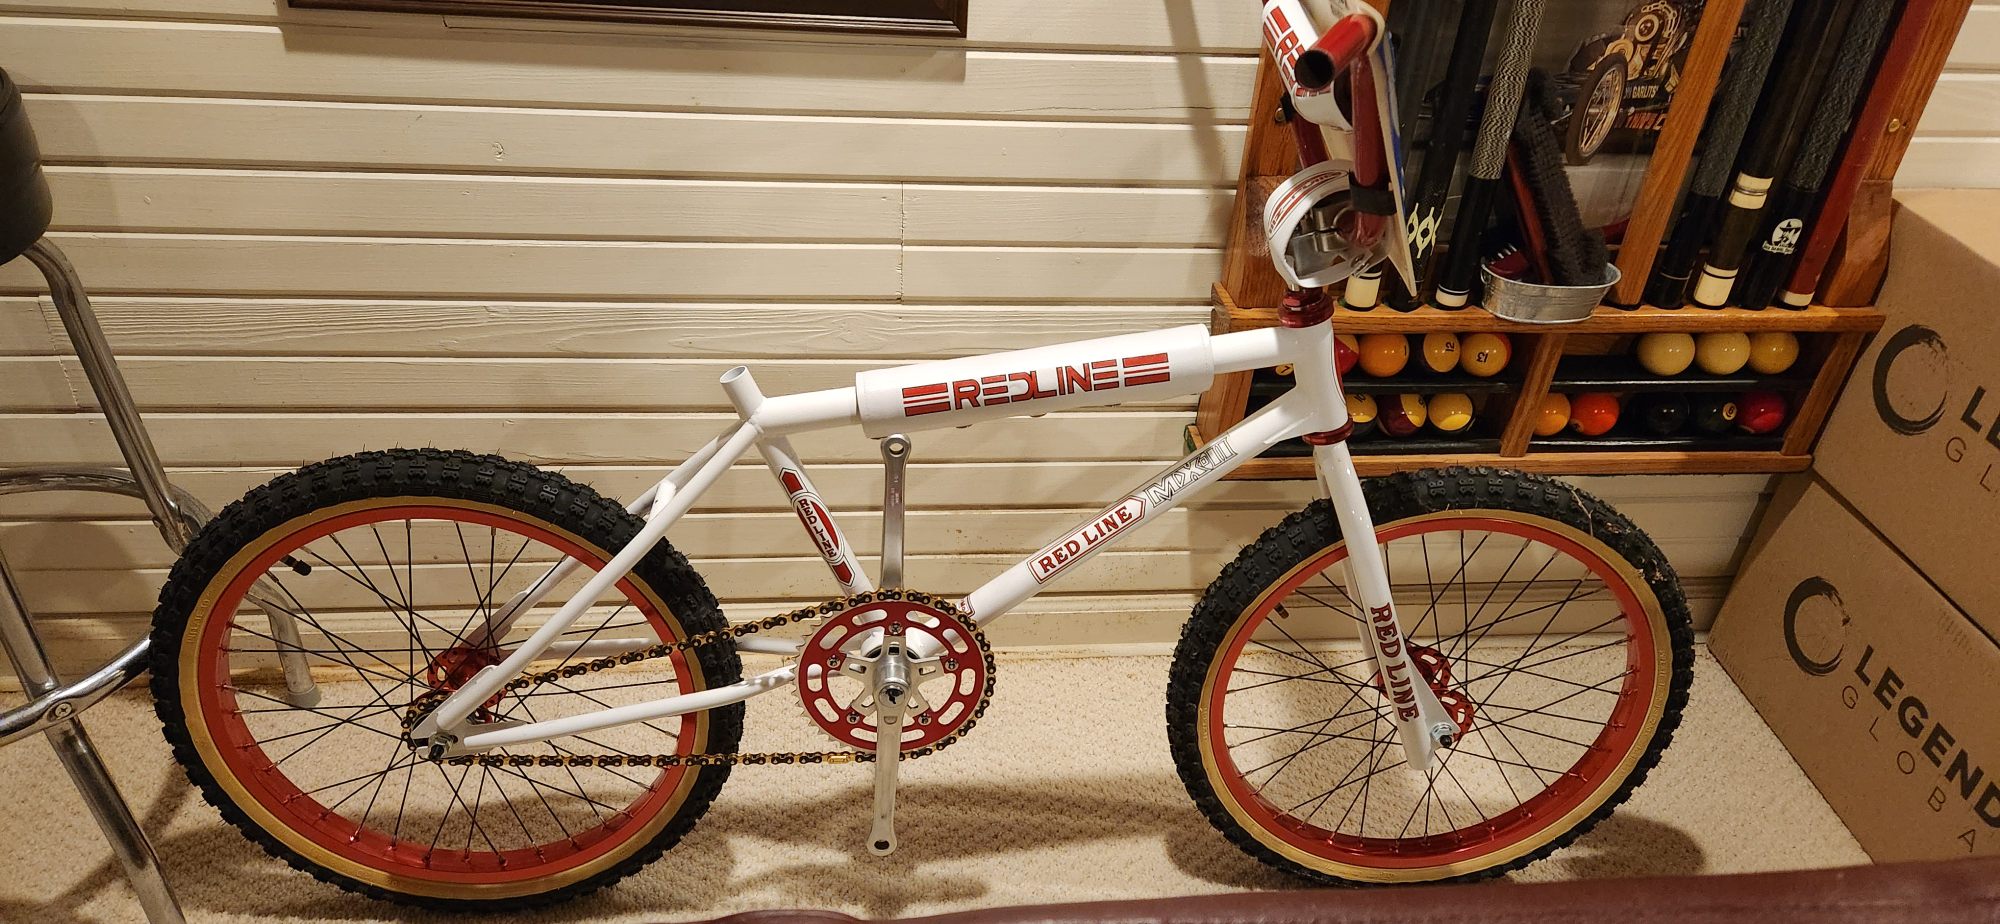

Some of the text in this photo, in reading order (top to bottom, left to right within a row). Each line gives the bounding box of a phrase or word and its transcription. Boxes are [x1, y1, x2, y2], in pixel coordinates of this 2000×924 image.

[1445, 341, 1455, 352] 12
[1475, 351, 1489, 364] 13
[952, 359, 1120, 410] REDLINE
[799, 499, 837, 558] RED LINE
[1038, 505, 1132, 574] RED LINE
[1370, 602, 1420, 722] RED LINE
[1854, 644, 2000, 829] LEGEND
